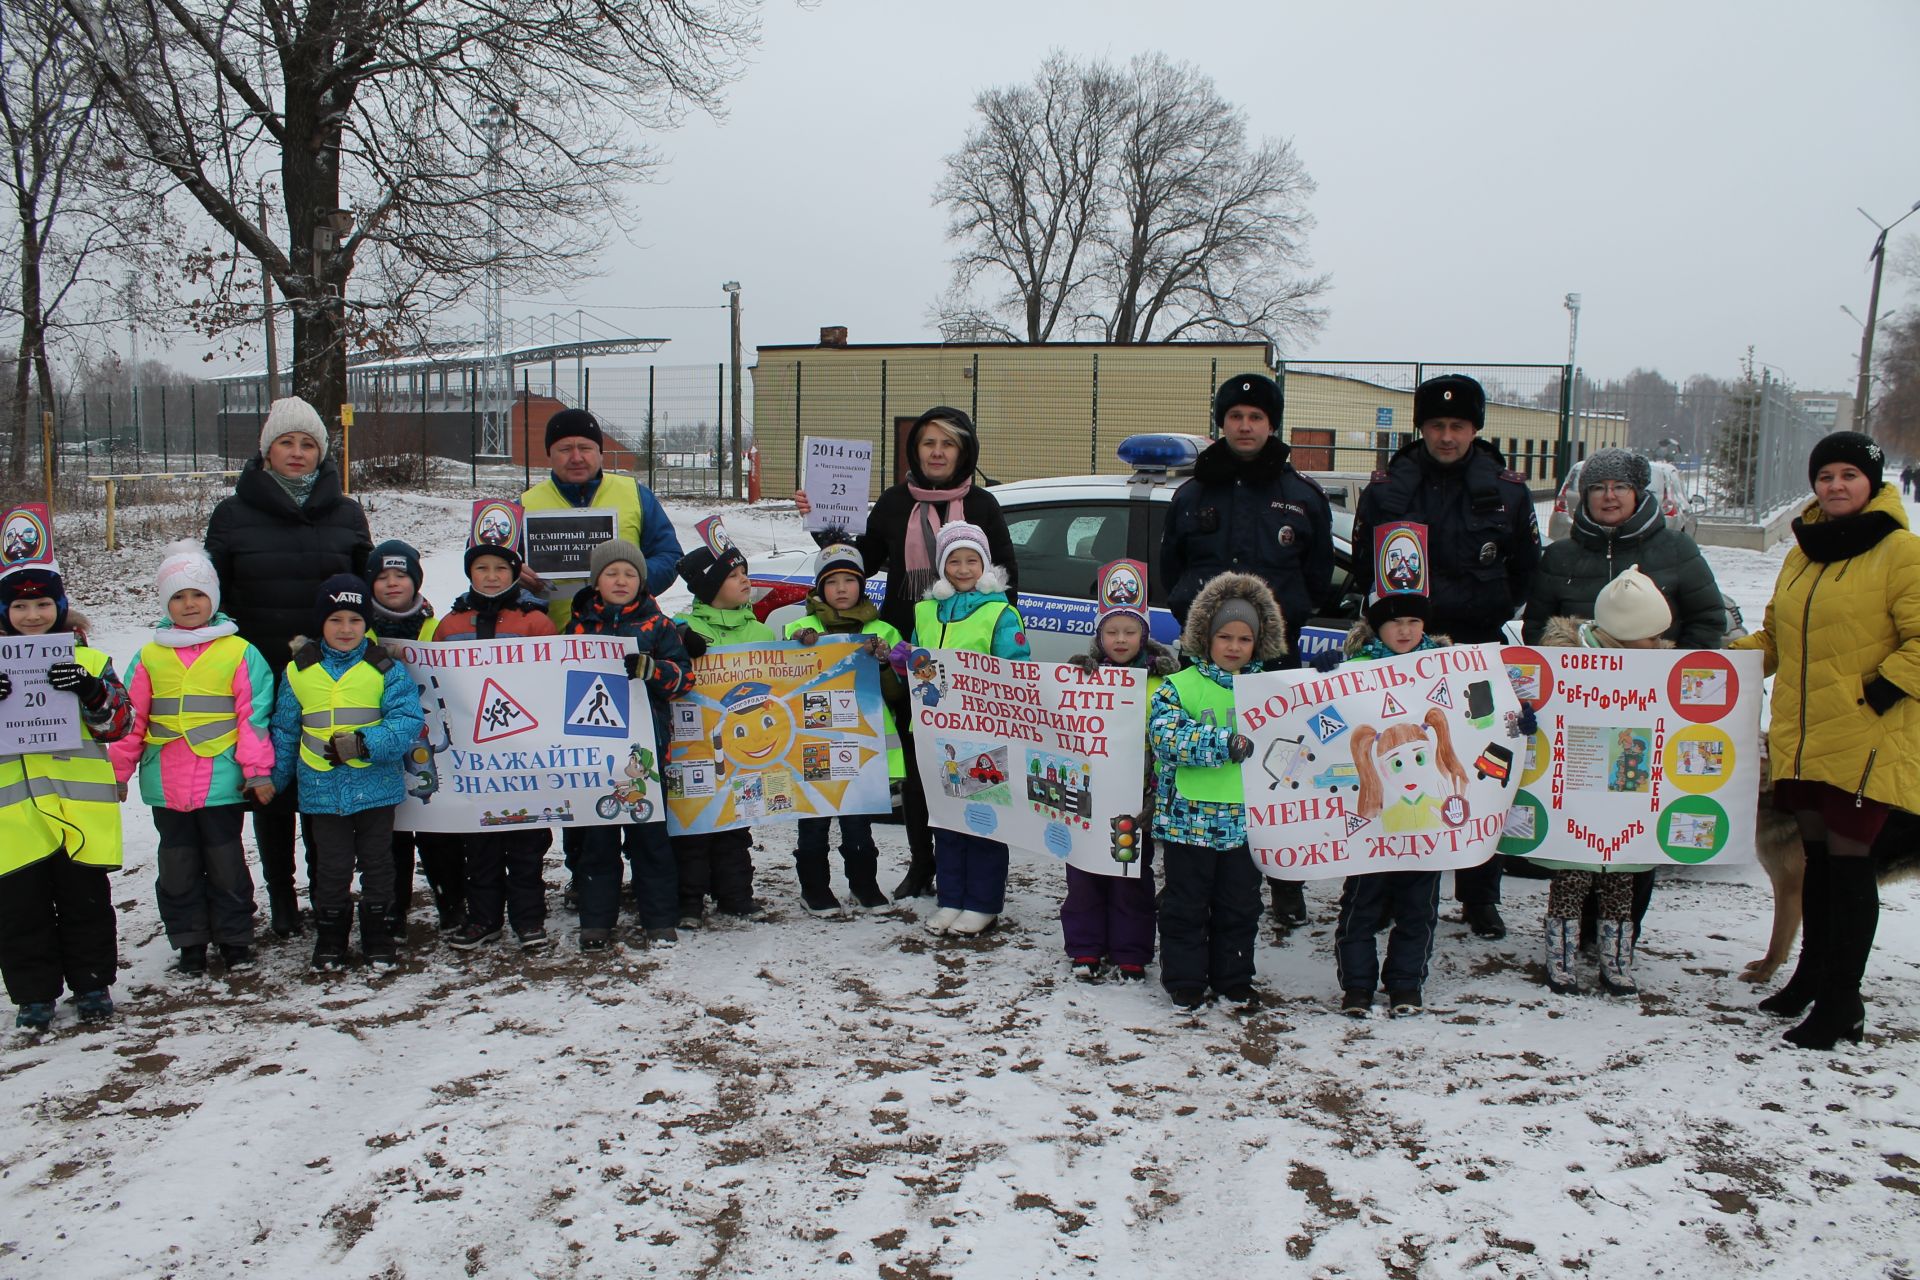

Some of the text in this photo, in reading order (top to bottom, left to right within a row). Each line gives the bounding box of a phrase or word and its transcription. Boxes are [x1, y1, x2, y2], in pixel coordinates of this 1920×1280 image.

[812, 444, 871, 460] 2014 год
[830, 483, 847, 496] 23
[815, 502, 858, 512] погибших
[830, 515, 850, 524] ДТП
[529, 530, 612, 541] ВСЕМИРНЫЙ ДЕНЬ
[533, 543, 570, 552] ПАМЯТИ
[562, 554, 580, 562] ДТП
[329, 591, 363, 605] VANS
[1045, 601, 1090, 613] дежурной
[1022, 615, 1097, 634] 4342) 520
[2, 643, 74, 660] 017 год
[402, 639, 627, 670] ОДИТЕЛИ И ДЕТИ
[749, 650, 788, 666] ЮИД
[954, 651, 1136, 687] ЧТОБ НЕ СТАТЬ
[1415, 645, 1488, 681] СТОЙ
[1561, 653, 1623, 671] СОВЕТЫ
[24, 691, 47, 708] 20
[951, 673, 1042, 706] ЖЕРТВОЙ
[1058, 690, 1115, 711] ДТП
[1557, 680, 1657, 712] СВЕТОФОРИКА
[6, 717, 67, 729] погибших
[961, 694, 1105, 734] НЕОБХОДИМО
[18, 732, 57, 745] в ДТП
[920, 709, 1109, 757] СОБЛЮДАТЬ ПДД
[450, 745, 603, 772] УВАЖАЙТЕ
[1551, 714, 1565, 810] КАЖДЫЙ
[1650, 717, 1665, 812] ДОЛЖЕН
[452, 772, 539, 794] ЗНАКИ
[1248, 796, 1347, 828] МЕНЯ
[1253, 838, 1351, 868] ТОЖЕ
[1365, 829, 1463, 861] ЖДУТ
[1567, 818, 1645, 862] ВЫПОЛНЯТЬ
